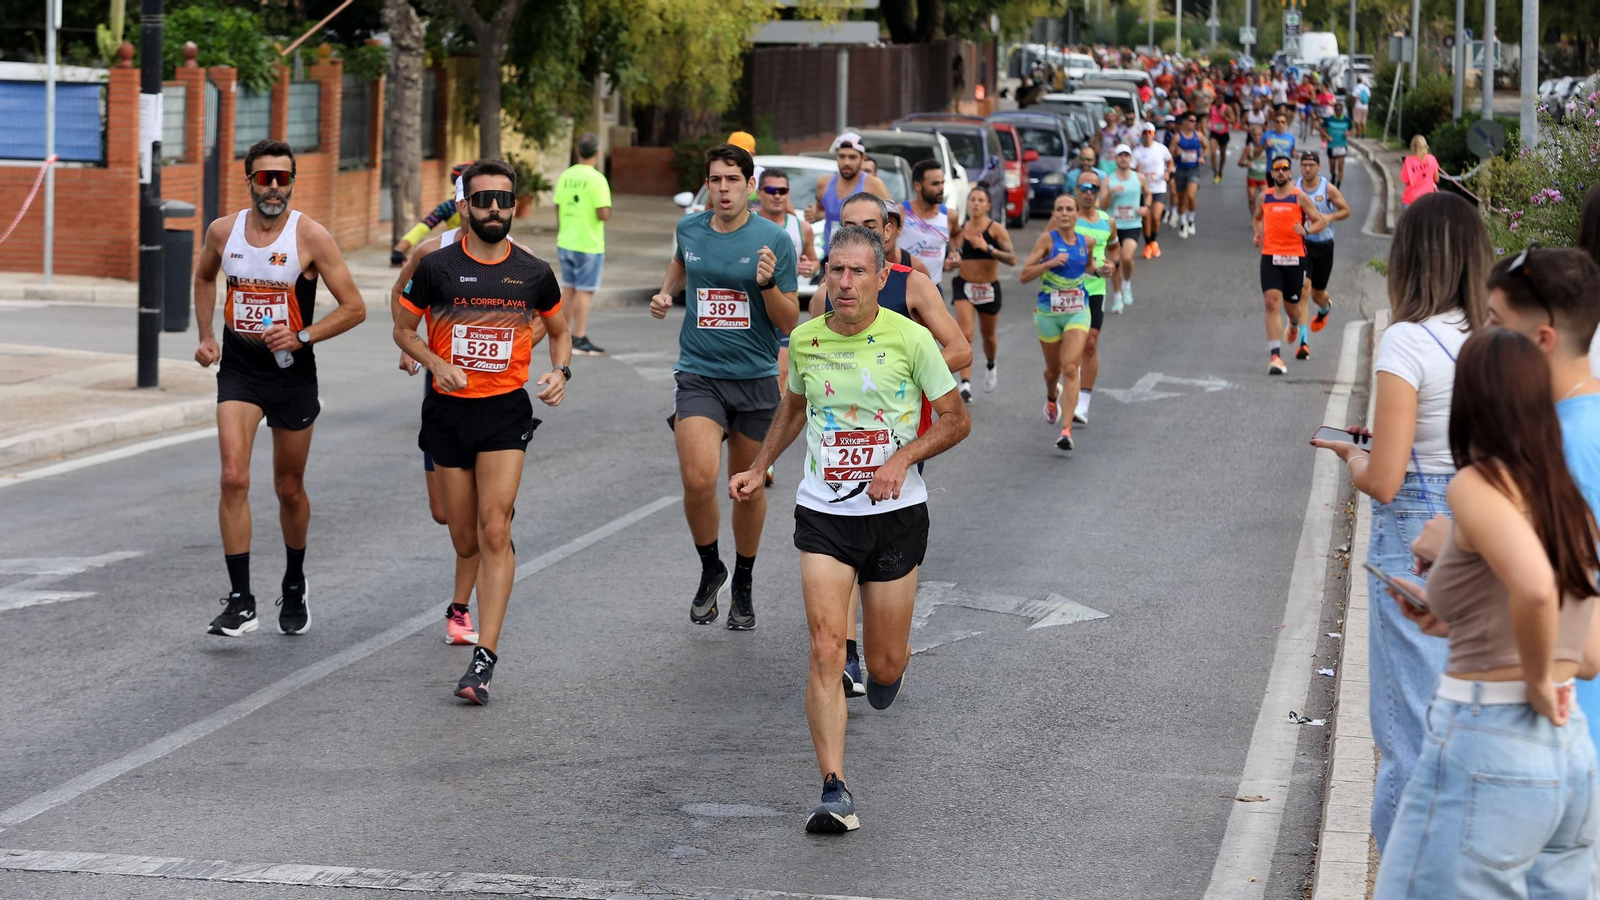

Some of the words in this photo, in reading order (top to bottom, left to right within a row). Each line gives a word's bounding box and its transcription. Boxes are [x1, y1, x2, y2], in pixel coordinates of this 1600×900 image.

[470, 298, 526, 307] CORREPLAYAS
[1060, 297, 1076, 306] 299
[245, 306, 273, 319] 260
[709, 302, 737, 316] 389
[467, 341, 499, 357] 528
[840, 437, 858, 445] XXIX
[838, 447, 874, 466] 267
